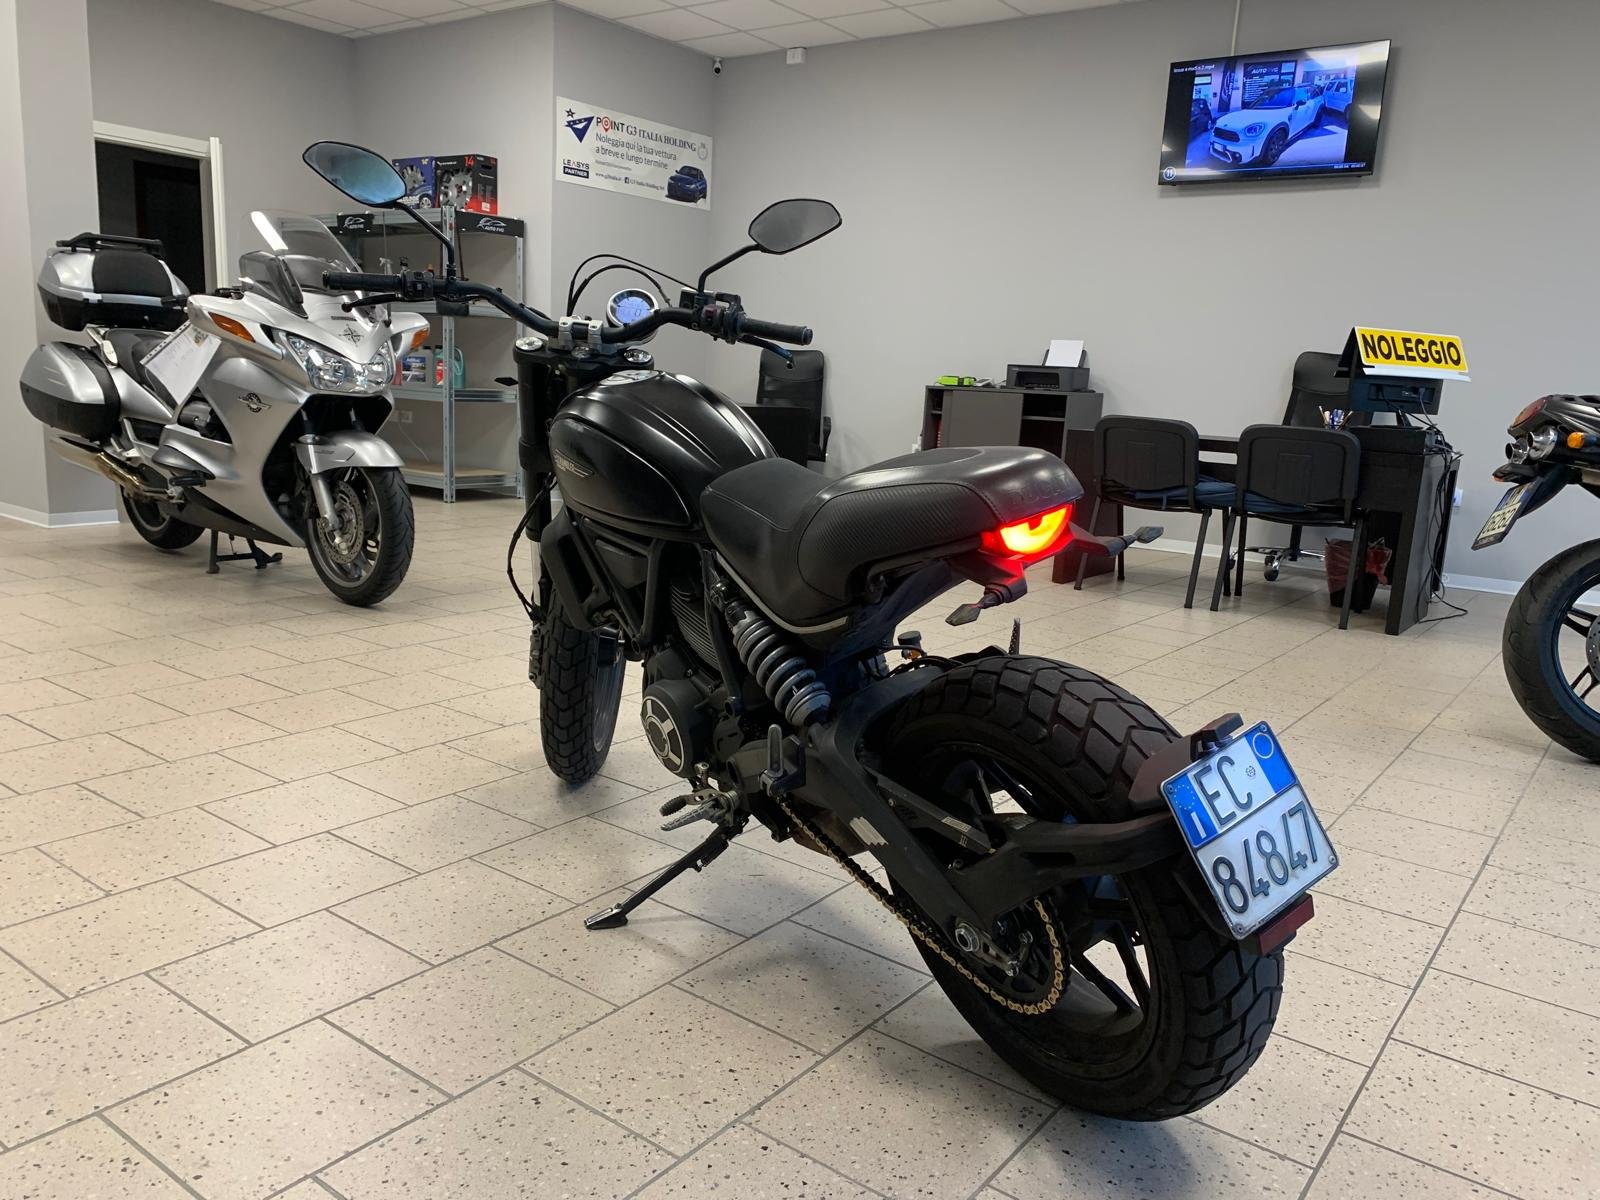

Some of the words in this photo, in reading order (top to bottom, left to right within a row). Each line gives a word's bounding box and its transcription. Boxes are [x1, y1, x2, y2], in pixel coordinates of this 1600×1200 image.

[595, 134, 625, 149] Noleggia
[626, 141, 636, 151] qui
[636, 142, 643, 152] la
[643, 145, 654, 156] tua
[654, 146, 677, 161] vettura
[596, 116, 625, 133] POINT
[626, 125, 637, 136] G3
[638, 130, 664, 144] ITALIA
[664, 136, 697, 152] HOLDING
[464, 157, 475, 167] 14
[564, 167, 589, 177] PARTNER
[595, 146, 600, 154] a
[601, 145, 620, 159] breve
[620, 152, 625, 160] e
[625, 150, 643, 165] lungo
[643, 156, 668, 170] termine
[1361, 333, 1461, 366] NOLEGGIO
[1193, 755, 1253, 826] EC
[1213, 800, 1318, 914] 84847
